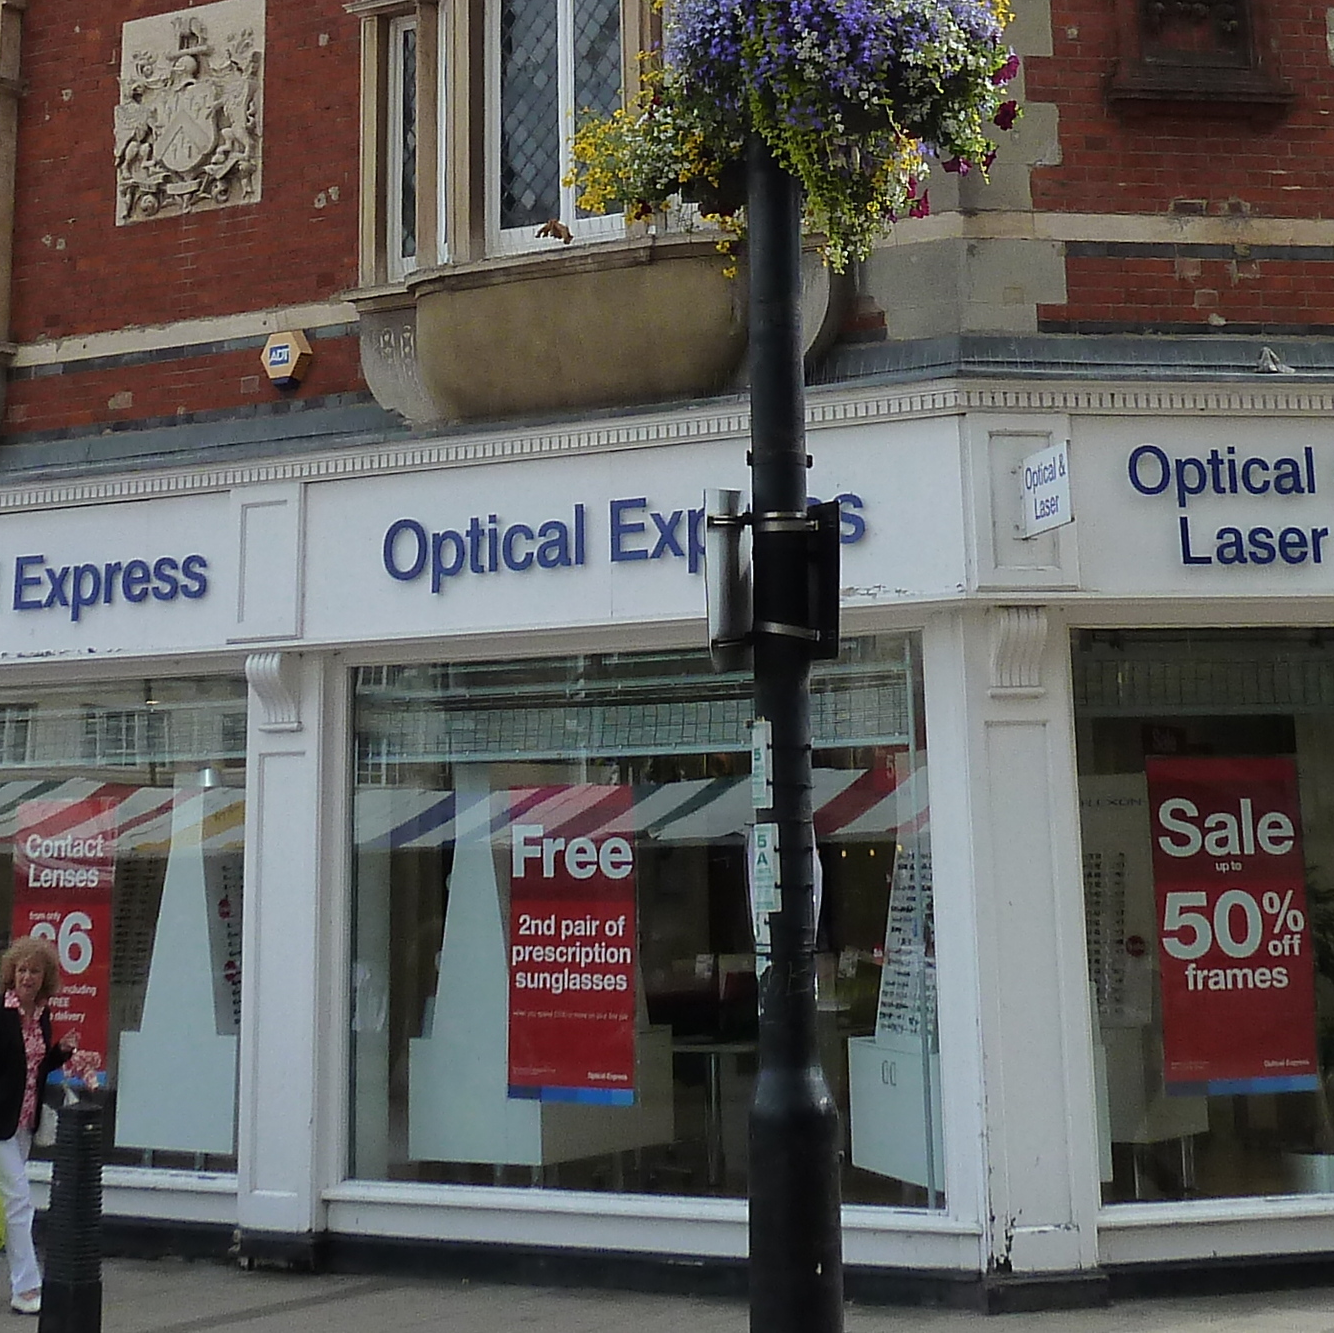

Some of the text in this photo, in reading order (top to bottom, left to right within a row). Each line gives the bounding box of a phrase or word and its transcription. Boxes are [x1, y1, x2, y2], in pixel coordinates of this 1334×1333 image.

[269, 348, 291, 363] ADT
[1025, 453, 1067, 494] Optical &
[1128, 445, 1316, 508] Optical
[1034, 495, 1060, 520] Laser
[383, 503, 585, 595] Optical
[1179, 516, 1329, 565] Laser
[12, 554, 208, 622] Express
[1158, 797, 1295, 858] Sale
[25, 833, 105, 858] Contact
[512, 824, 633, 879] Free
[28, 863, 99, 888] Lenses
[1215, 861, 1242, 873] up to
[29, 910, 62, 922] from only
[518, 914, 626, 941] 2nd pair of
[1162, 889, 1304, 960] 50%
[512, 941, 631, 967] prescription
[1268, 934, 1302, 957] off
[515, 967, 628, 994] sunglasses
[1185, 963, 1289, 991] frames
[48, 997, 70, 1007] FREE
[54, 1011, 86, 1023] delivery
